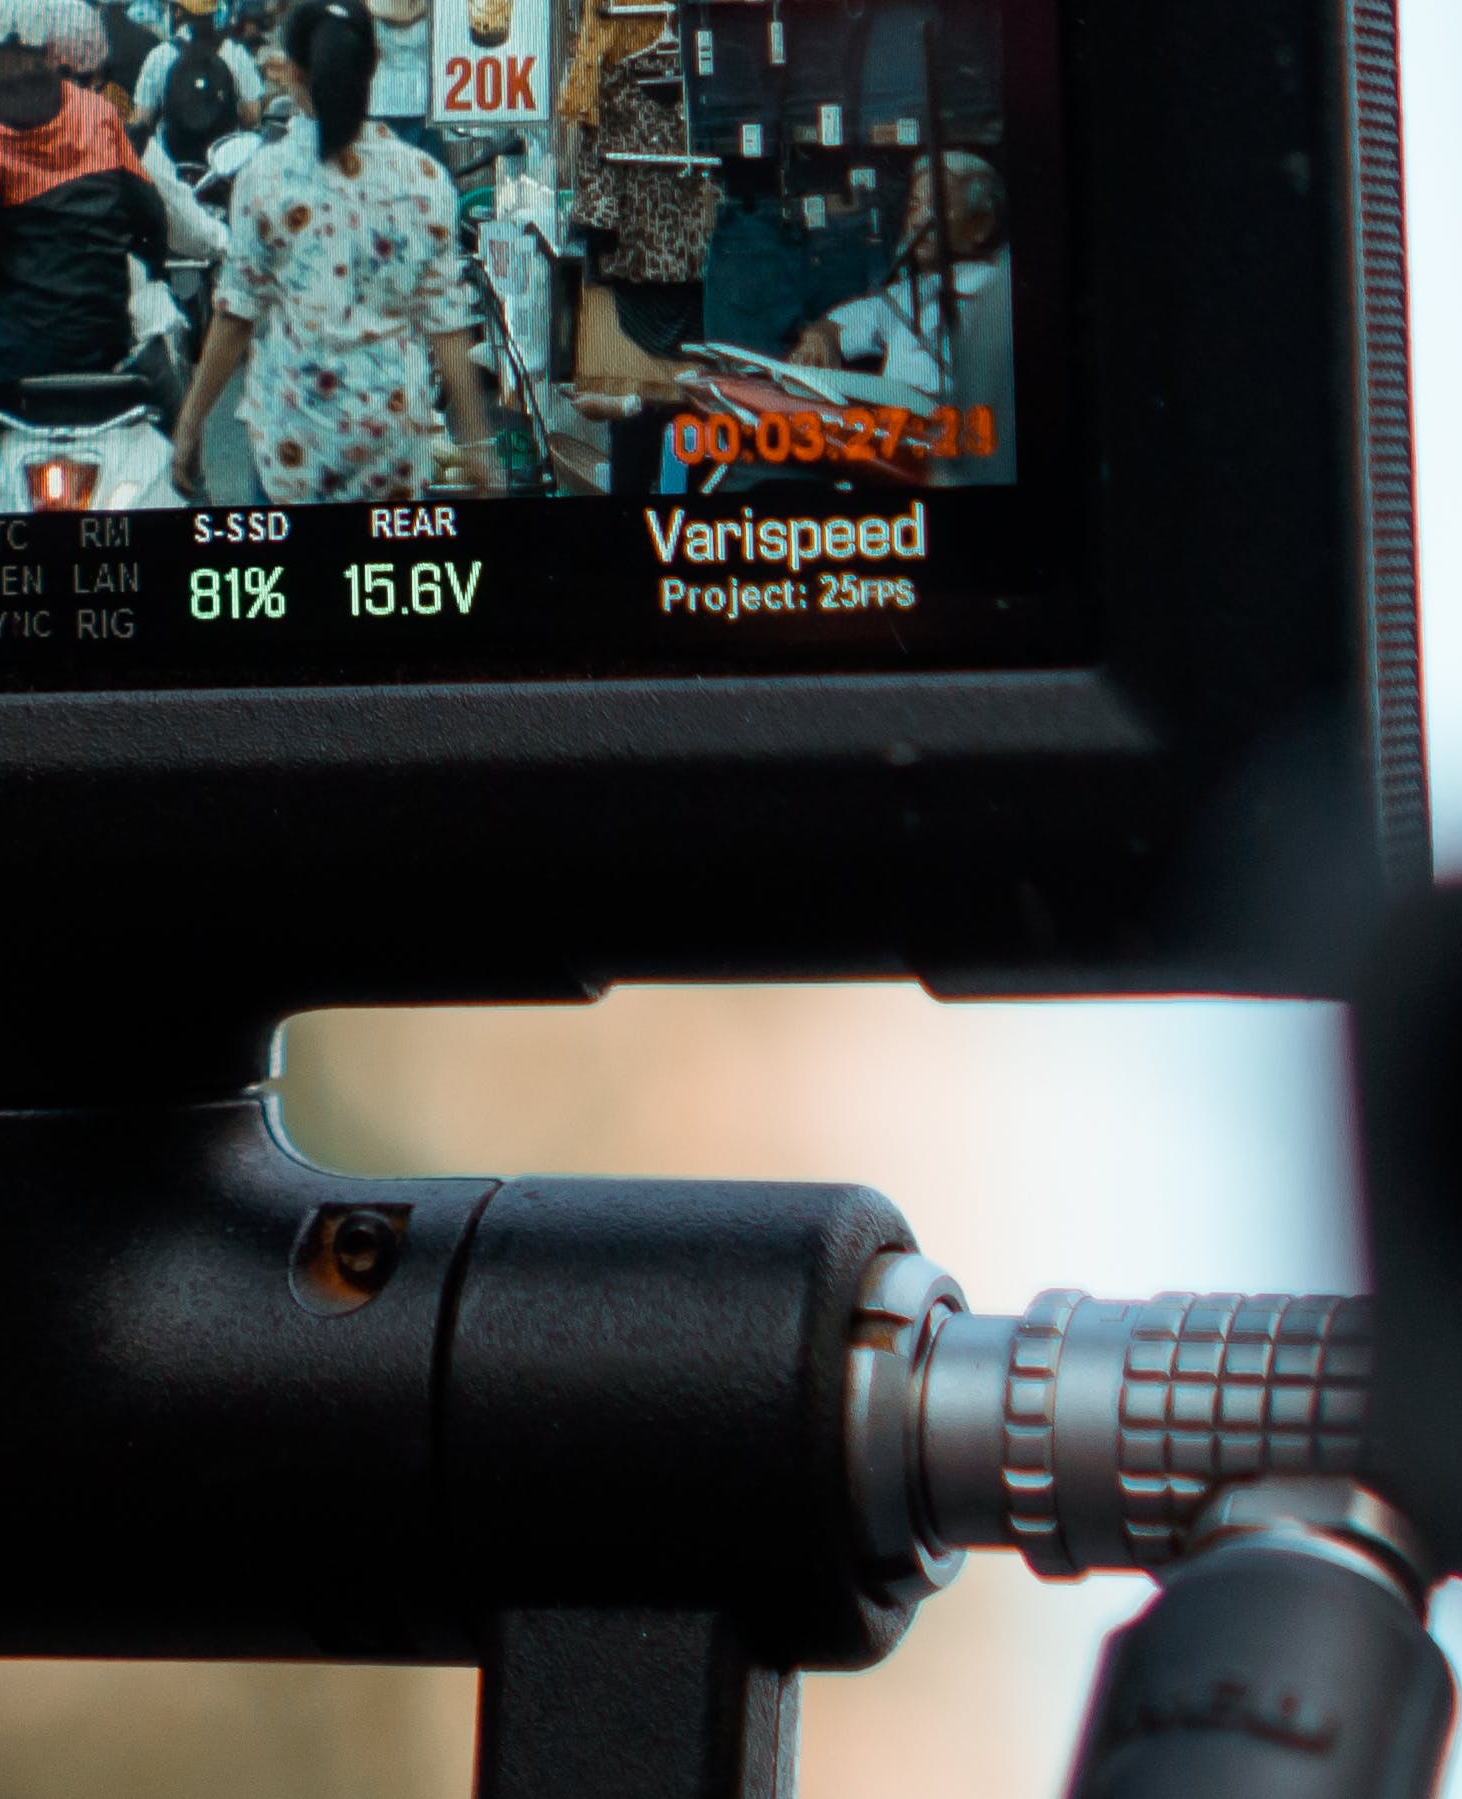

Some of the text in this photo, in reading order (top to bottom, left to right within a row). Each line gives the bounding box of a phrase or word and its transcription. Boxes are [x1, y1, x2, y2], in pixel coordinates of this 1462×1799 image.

[444, 56, 537, 112] 20K
[193, 511, 290, 544] S-SSD
[371, 506, 458, 538] REAR
[645, 501, 926, 570] Varispeed
[74, 562, 138, 594] LAN
[189, 566, 287, 620] 81%
[343, 560, 482, 616] 15.6V
[661, 574, 917, 619] Project: 25FPS
[77, 608, 134, 640] RIG
